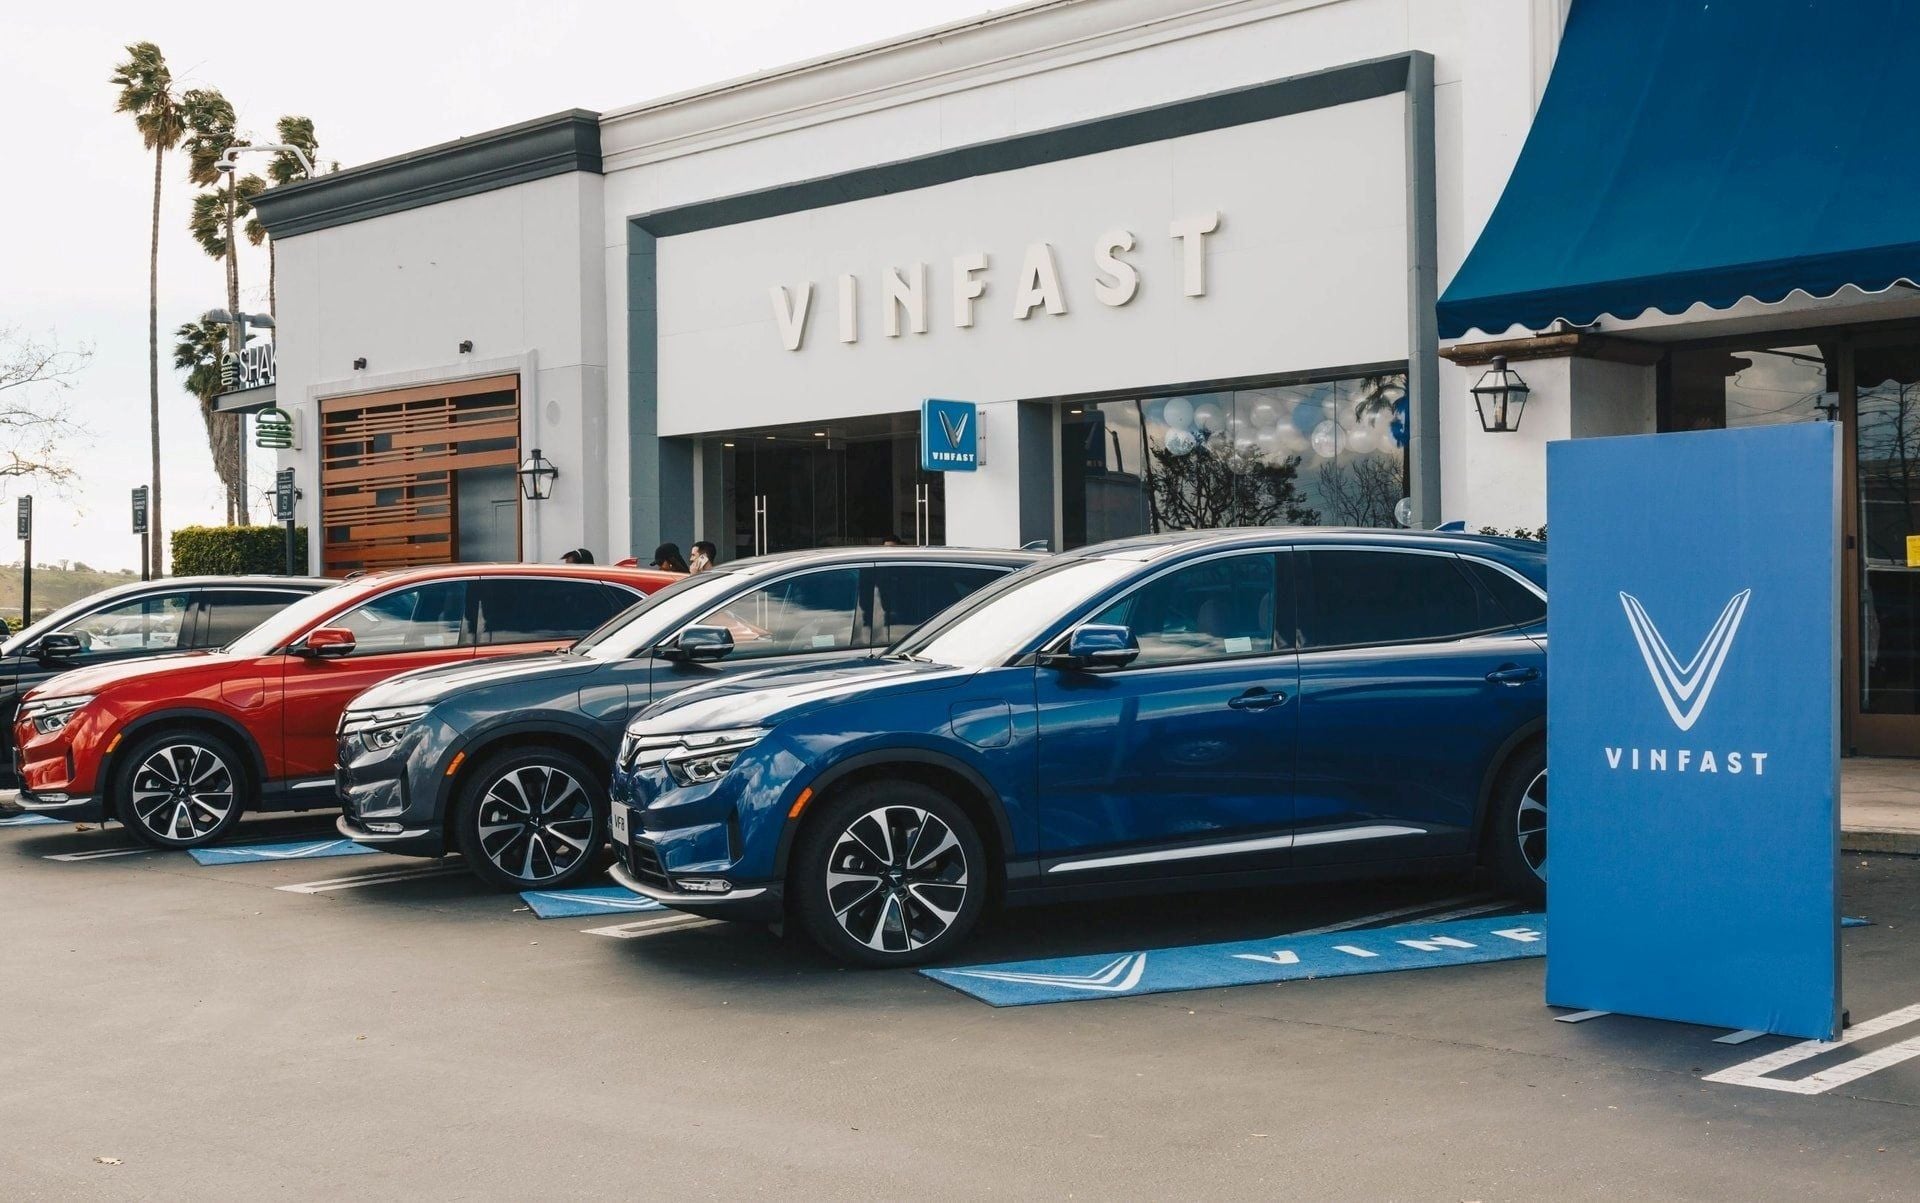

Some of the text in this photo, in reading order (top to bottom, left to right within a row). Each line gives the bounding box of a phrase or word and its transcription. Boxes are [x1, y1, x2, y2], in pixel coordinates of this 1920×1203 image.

[769, 209, 1223, 352] VINFAST
[932, 451, 975, 462] VINFAST
[1604, 747, 1768, 776] VINFAST
[1230, 927, 1542, 965] VINF
